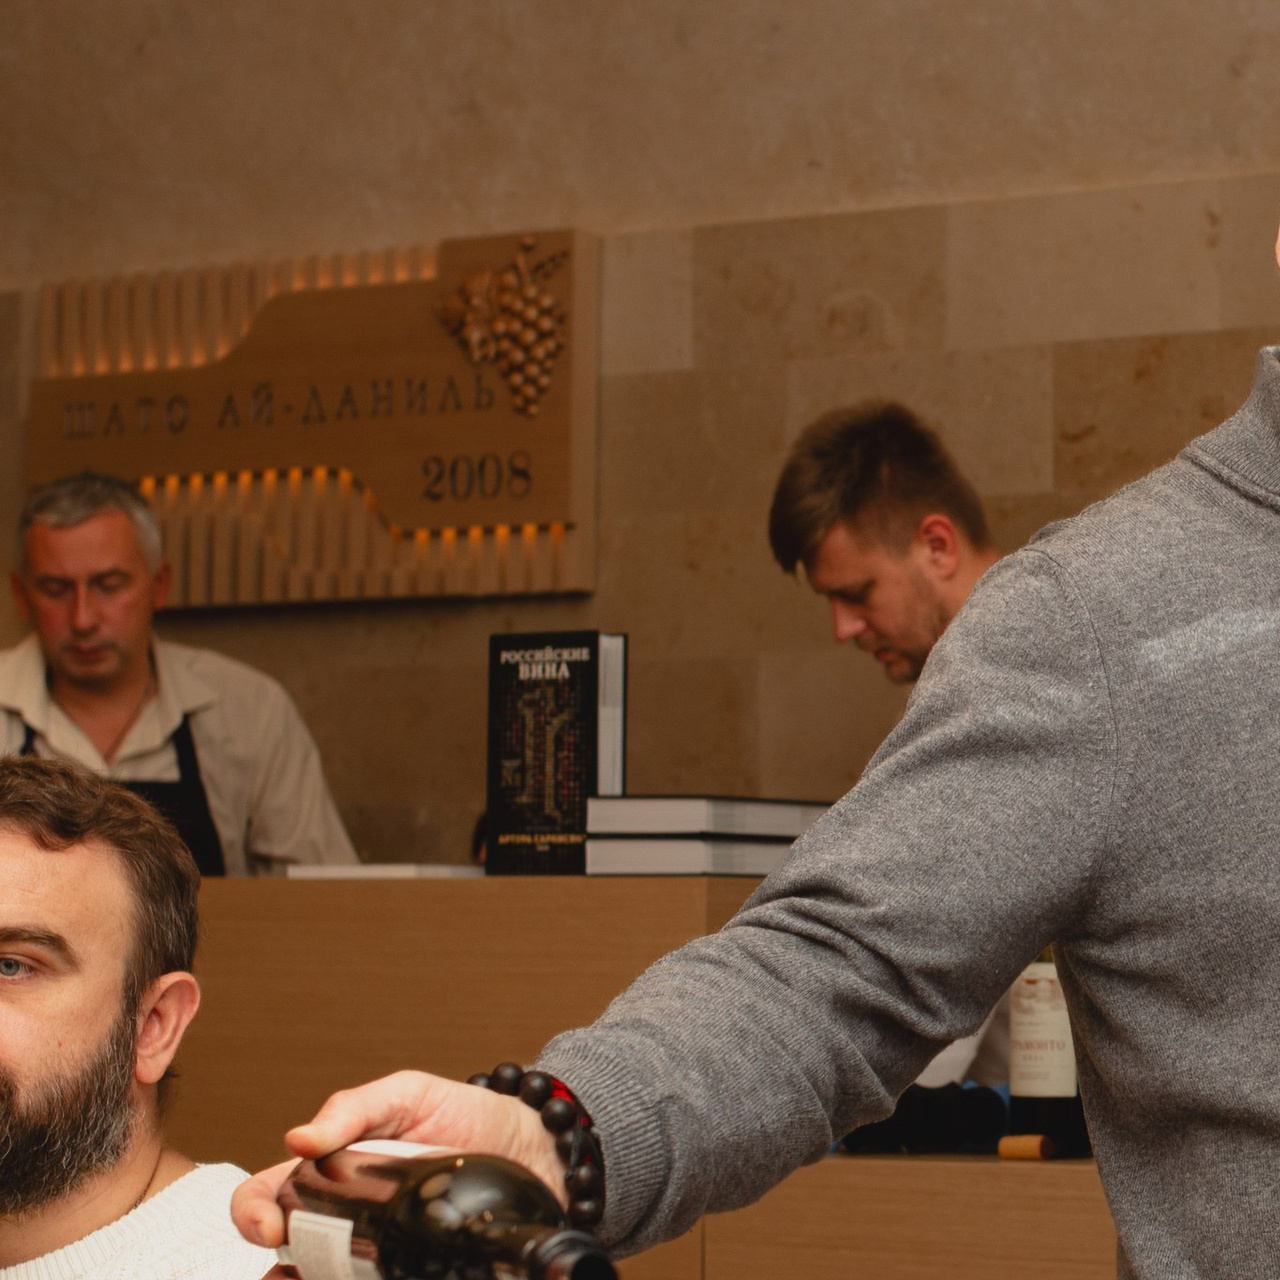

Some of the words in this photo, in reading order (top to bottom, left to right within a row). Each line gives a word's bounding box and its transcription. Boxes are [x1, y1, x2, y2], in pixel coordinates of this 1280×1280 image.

[63, 393, 191, 440] ШАТО
[421, 450, 533, 503] 2008
[500, 646, 590, 665] РОССИЙСКИЕ
[518, 661, 570, 681] ВИНА
